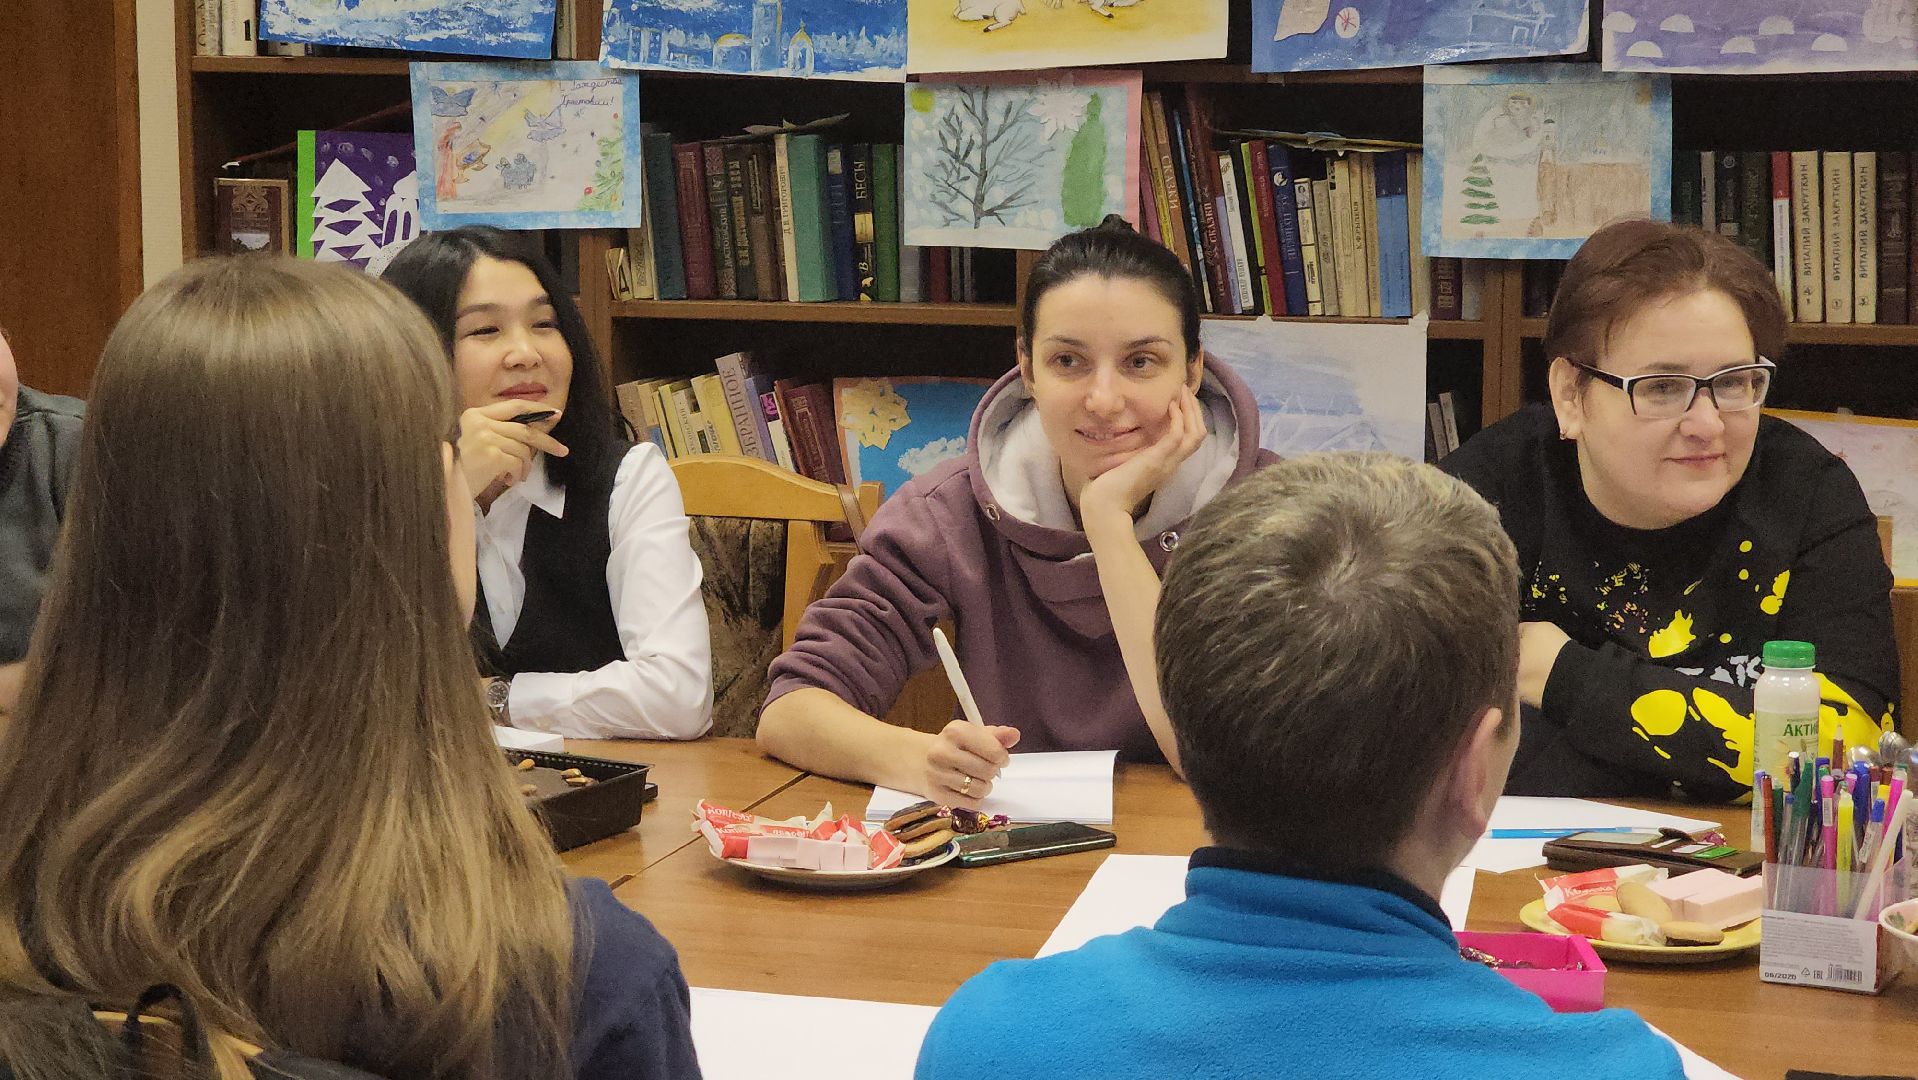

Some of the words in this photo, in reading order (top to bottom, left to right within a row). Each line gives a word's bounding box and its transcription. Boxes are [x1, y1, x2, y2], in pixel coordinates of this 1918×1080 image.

[854, 161, 867, 200] БЕСЫ
[1161, 155, 1178, 209] СКАЗКИ
[1800, 164, 1811, 223] ЗАКРУТКИН
[1830, 169, 1841, 227] ЗАКРУТКИН
[1858, 166, 1869, 224] ЗАКРУТКИН
[1203, 202, 1217, 243] СКАЗКИ
[1801, 227, 1811, 276] ВИТАЛИЙ
[1830, 232, 1841, 280] ВИТАЛИЙ
[1858, 230, 1869, 278] ВИТАЛИЙ
[722, 367, 760, 458] ЗБРАННОЕ
